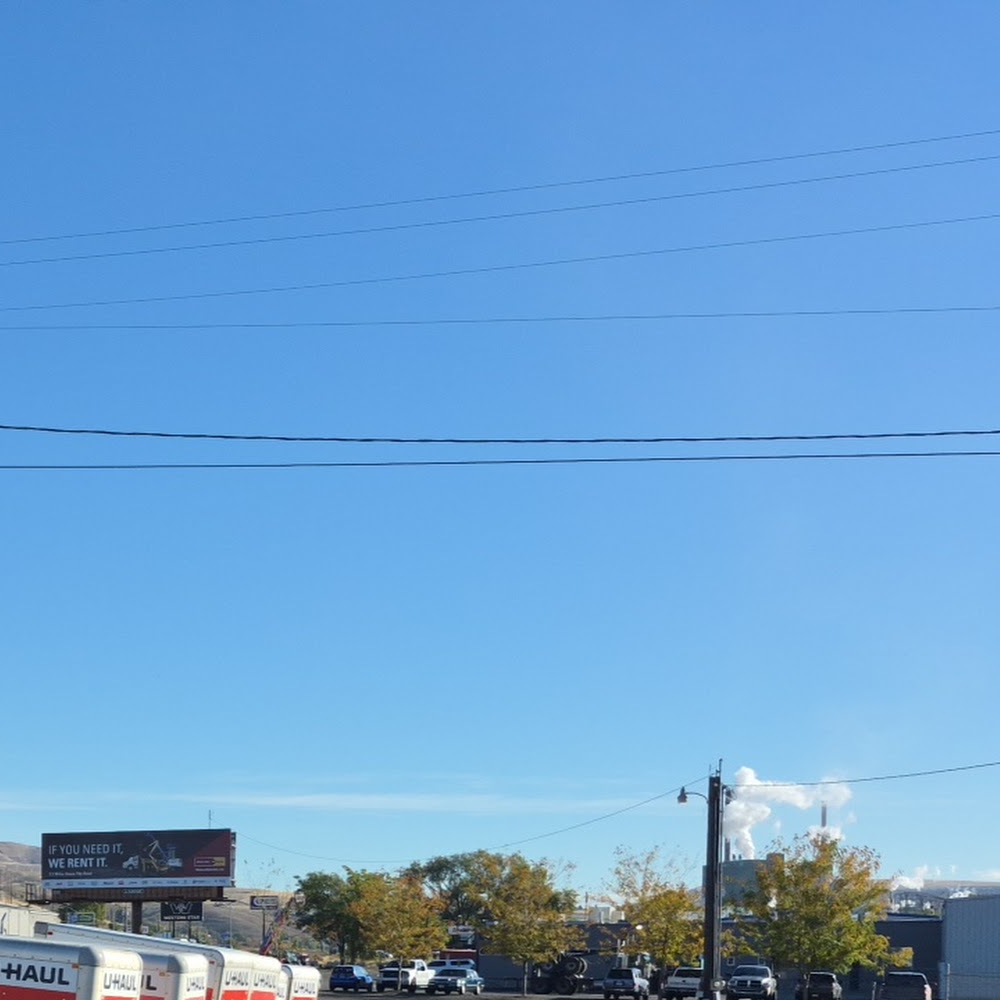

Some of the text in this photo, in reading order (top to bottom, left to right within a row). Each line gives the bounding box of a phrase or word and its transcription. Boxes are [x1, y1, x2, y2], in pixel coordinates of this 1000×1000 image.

[48, 844, 58, 855] IF
[59, 844, 80, 855] YOU
[82, 843, 110, 855] NEED
[48, 857, 66, 869] WE
[67, 857, 94, 869] RENT
[103, 973, 137, 992] U-HAUL
